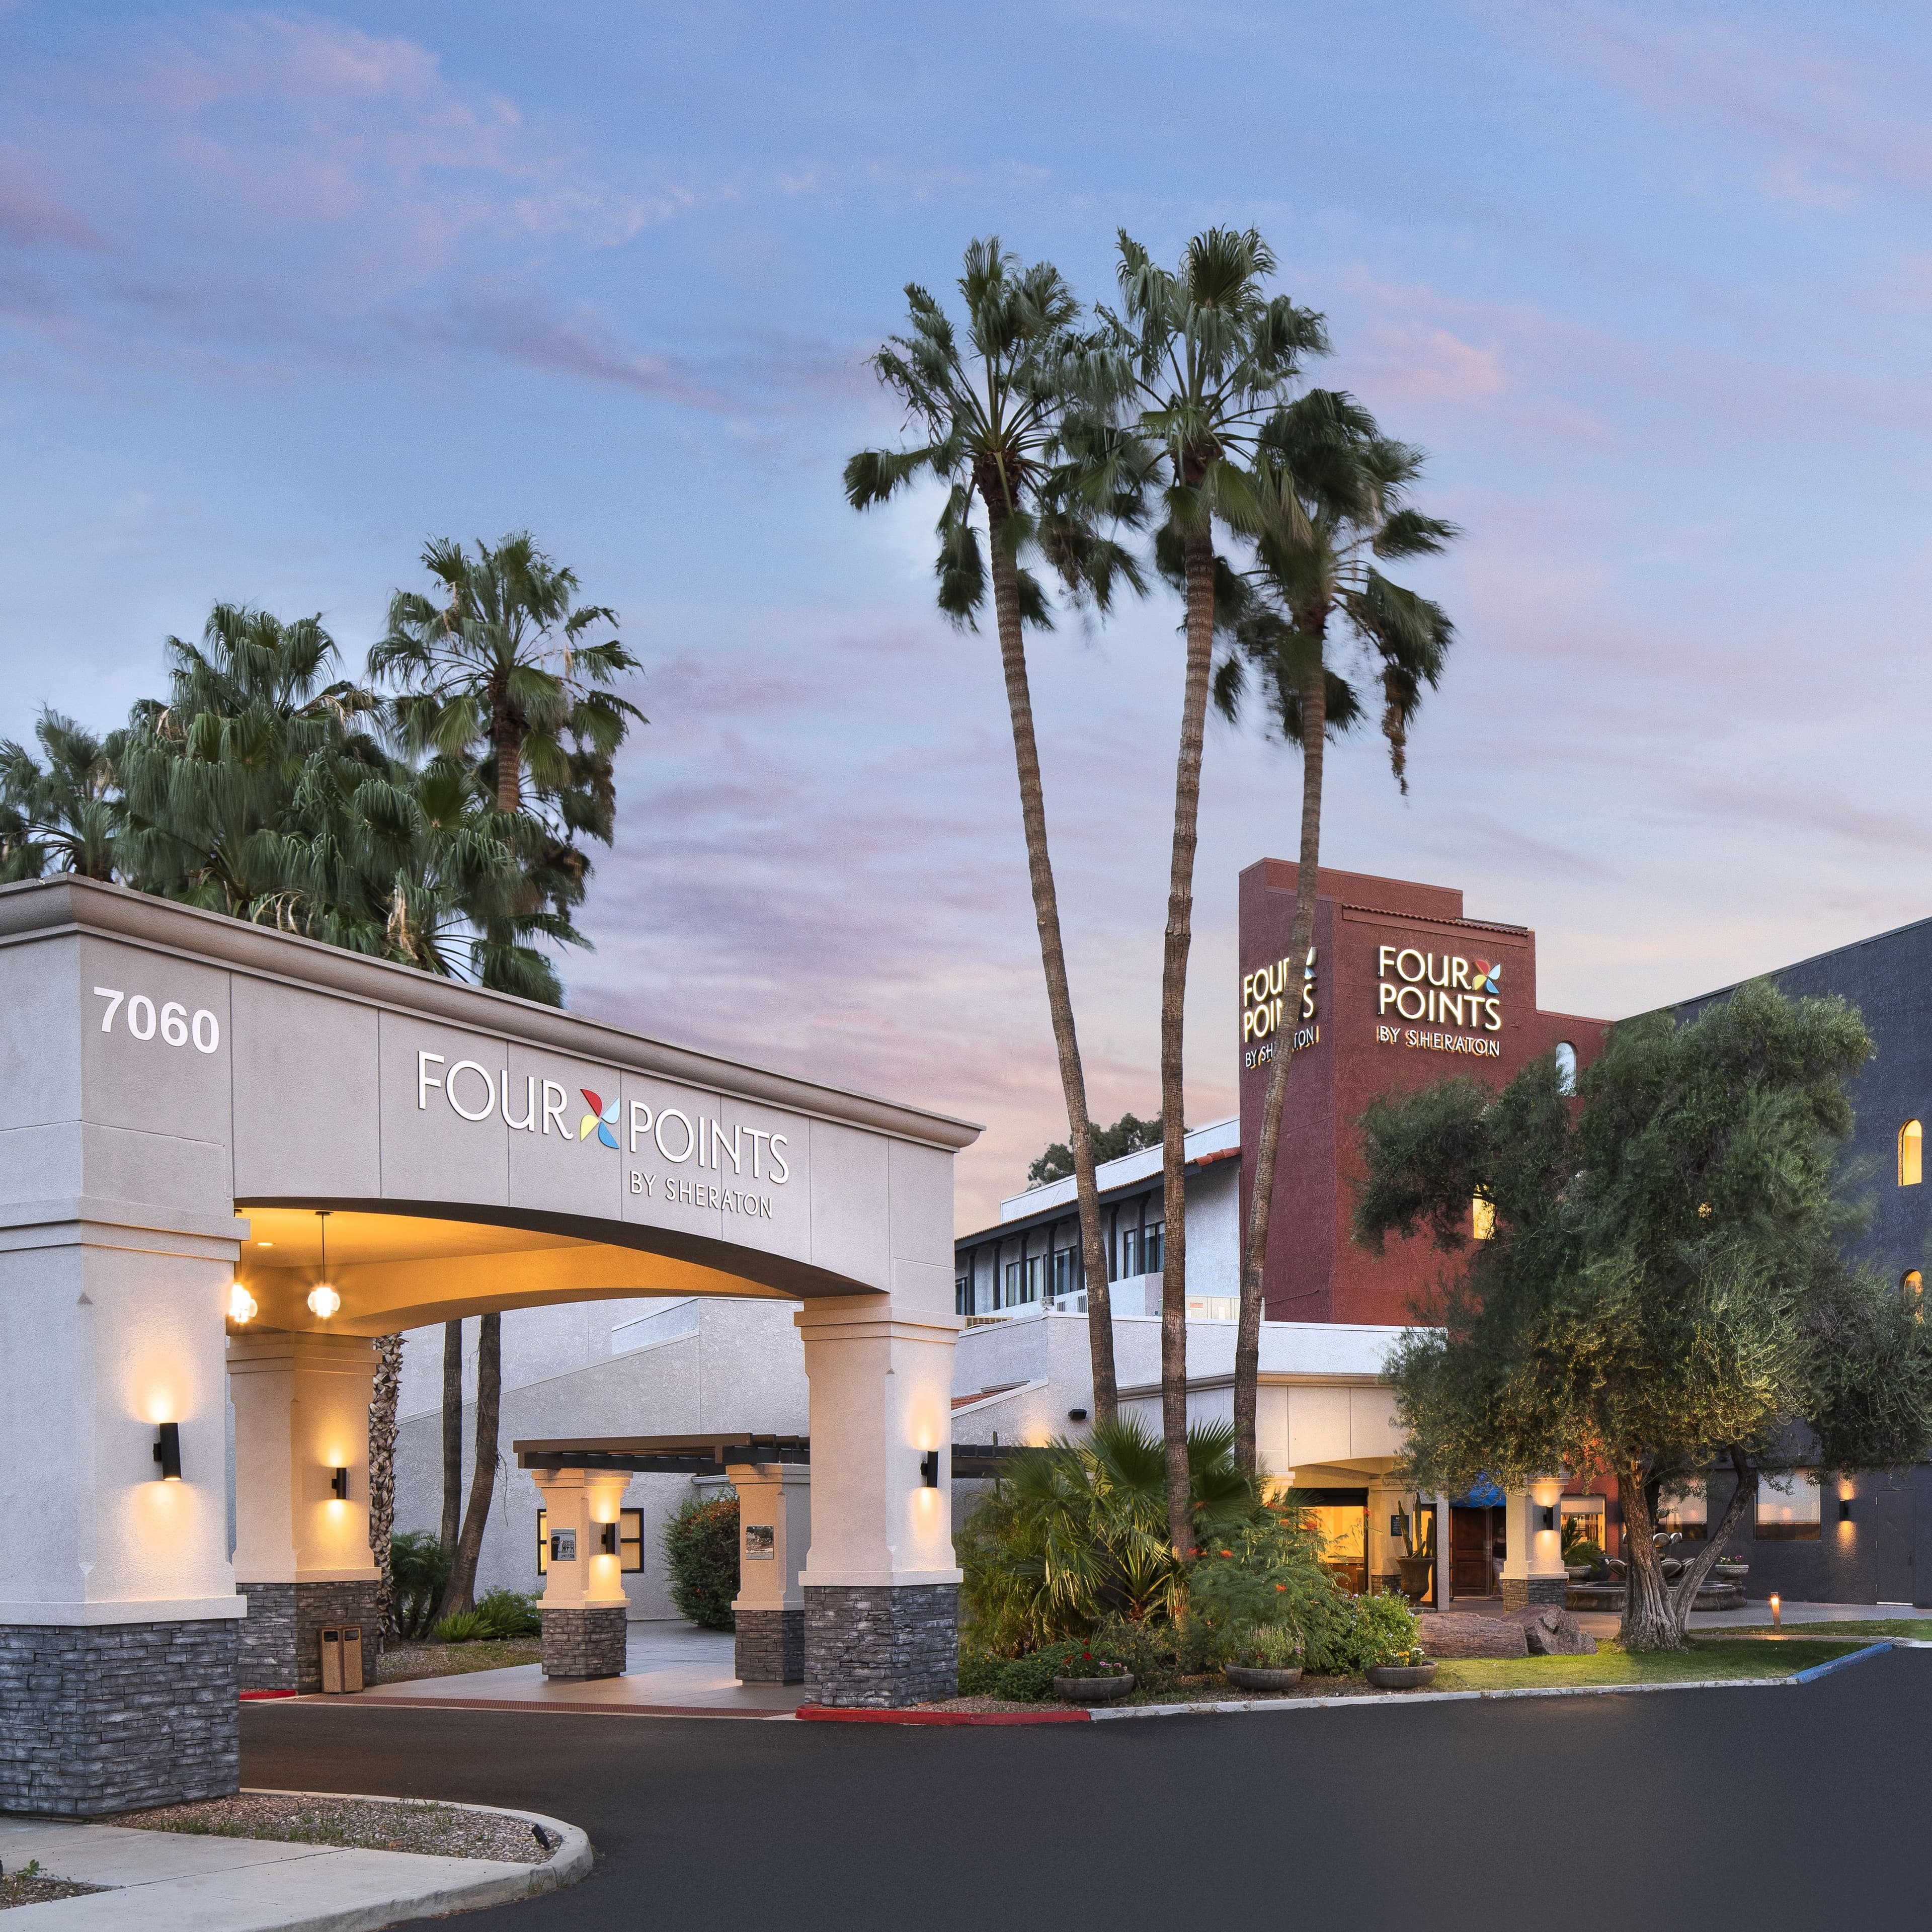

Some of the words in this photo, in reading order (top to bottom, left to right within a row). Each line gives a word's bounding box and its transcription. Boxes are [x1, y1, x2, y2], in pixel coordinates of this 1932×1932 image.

[1379, 945, 1472, 990] FOUR
[94, 986, 220, 1055] 7060
[1244, 983, 1314, 1043] POIS
[1379, 983, 1501, 1030] POINTS
[1245, 1049, 1258, 1068] BY
[1261, 1025, 1314, 1062] SHTON
[1380, 1025, 1401, 1042] BY
[1408, 1029, 1500, 1056] SHERATON
[417, 1050, 574, 1140] FOUR
[629, 1099, 790, 1184] POINTS
[630, 1170, 658, 1197] BY
[665, 1177, 773, 1219] SHERATON
